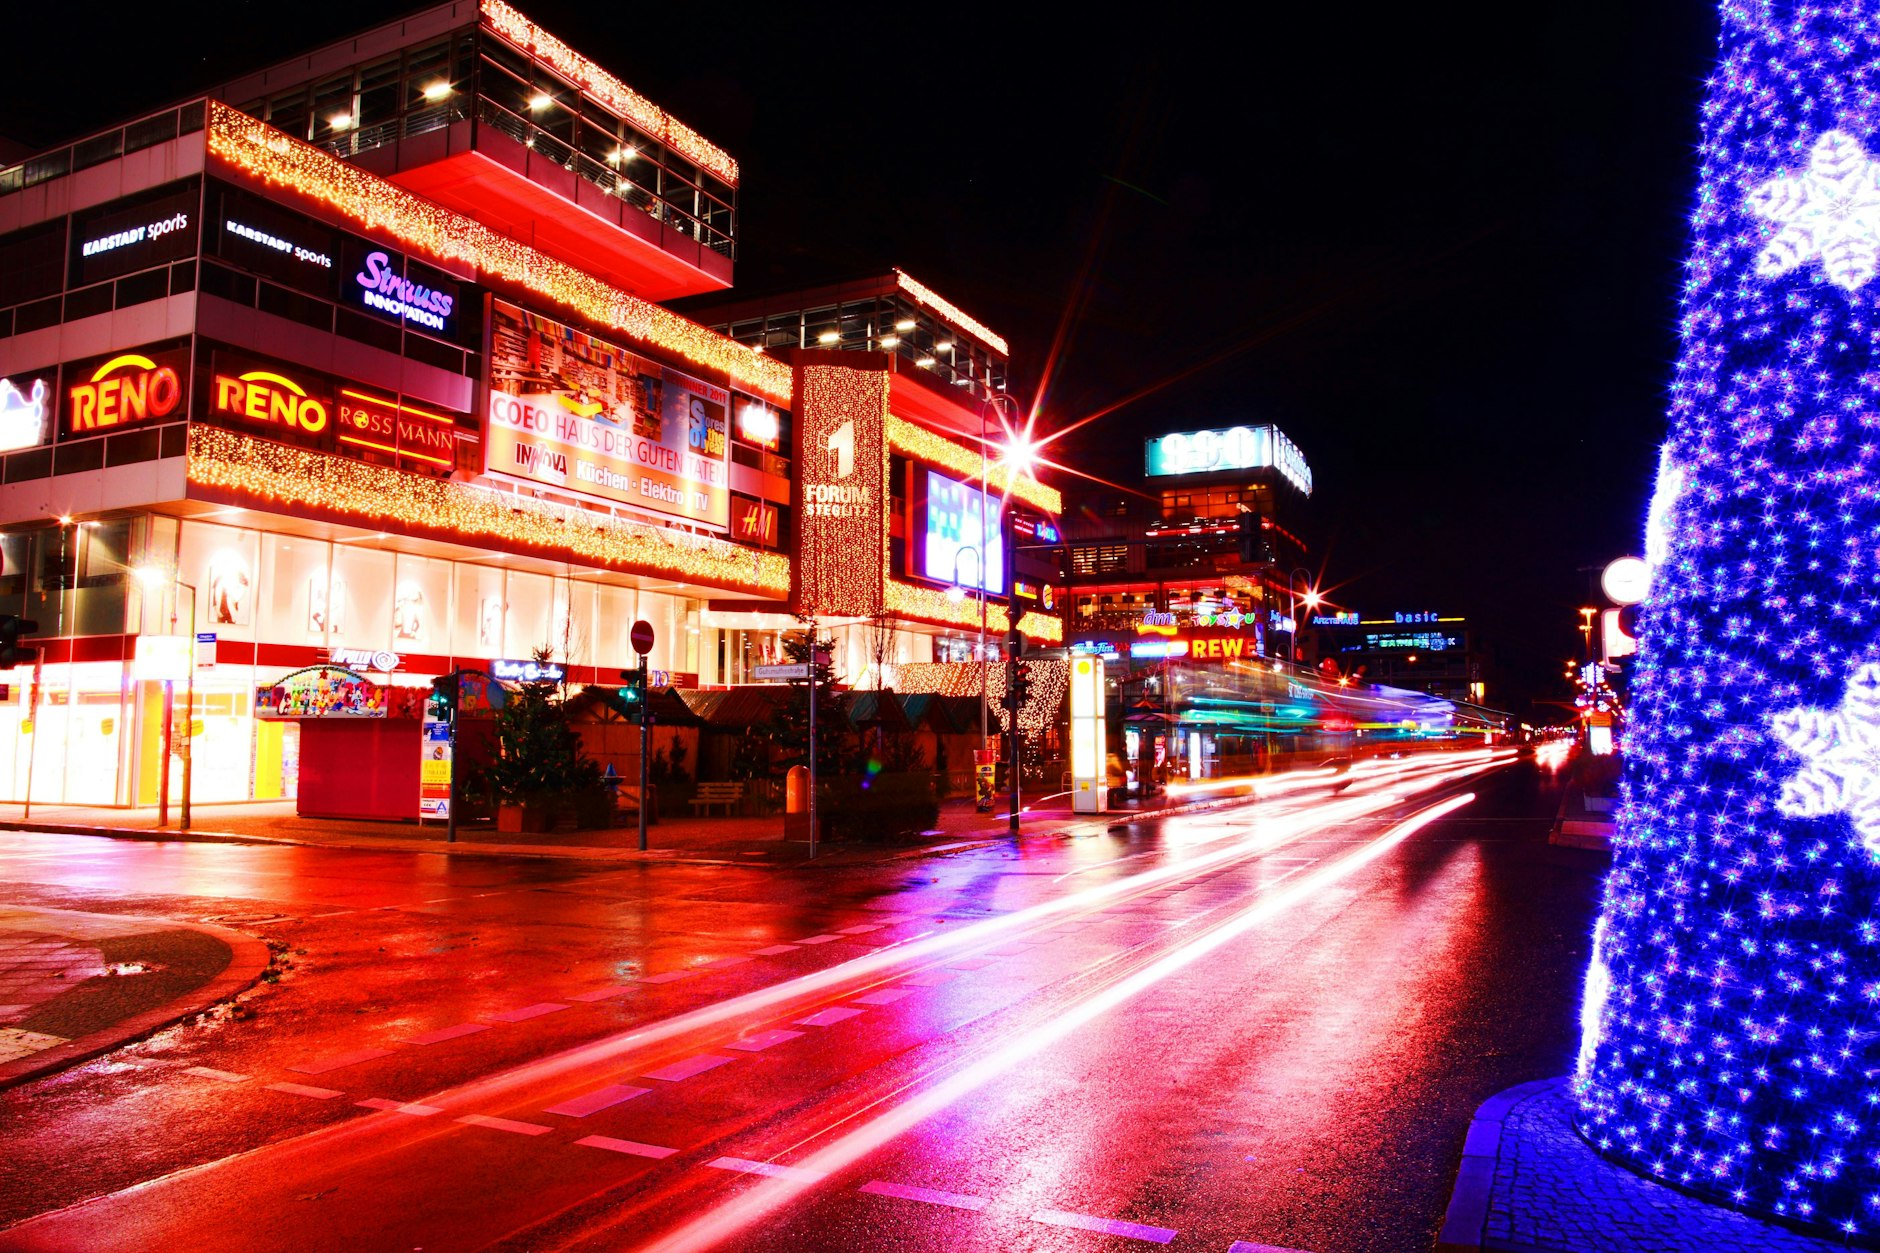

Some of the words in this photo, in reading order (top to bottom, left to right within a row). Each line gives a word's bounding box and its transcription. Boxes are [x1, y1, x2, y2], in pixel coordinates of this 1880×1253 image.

[83, 225, 146, 256] KARSTADT
[147, 211, 188, 242] sports
[226, 220, 293, 254] KARSTADT
[294, 244, 332, 269] sports
[356, 252, 454, 317] Strauss
[364, 290, 444, 331] INNOVATION
[71, 366, 184, 433] RENO
[216, 373, 328, 434] RENO
[710, 388, 726, 403] 2011
[339, 408, 453, 450] ROSSMANN
[492, 397, 549, 433] COEO
[556, 416, 600, 448] HAUS
[605, 431, 633, 459] DER
[637, 441, 683, 474] GUTEN
[703, 438, 725, 455] year
[706, 427, 725, 444] the
[576, 458, 629, 491] Küchen
[640, 476, 684, 506] Elektro
[694, 491, 708, 511] TV
[806, 484, 869, 503] FORUM
[742, 504, 773, 540] H&M
[806, 503, 869, 517] STEGLITZ
[1143, 607, 1172, 626] dm
[1395, 611, 1438, 624] basic
